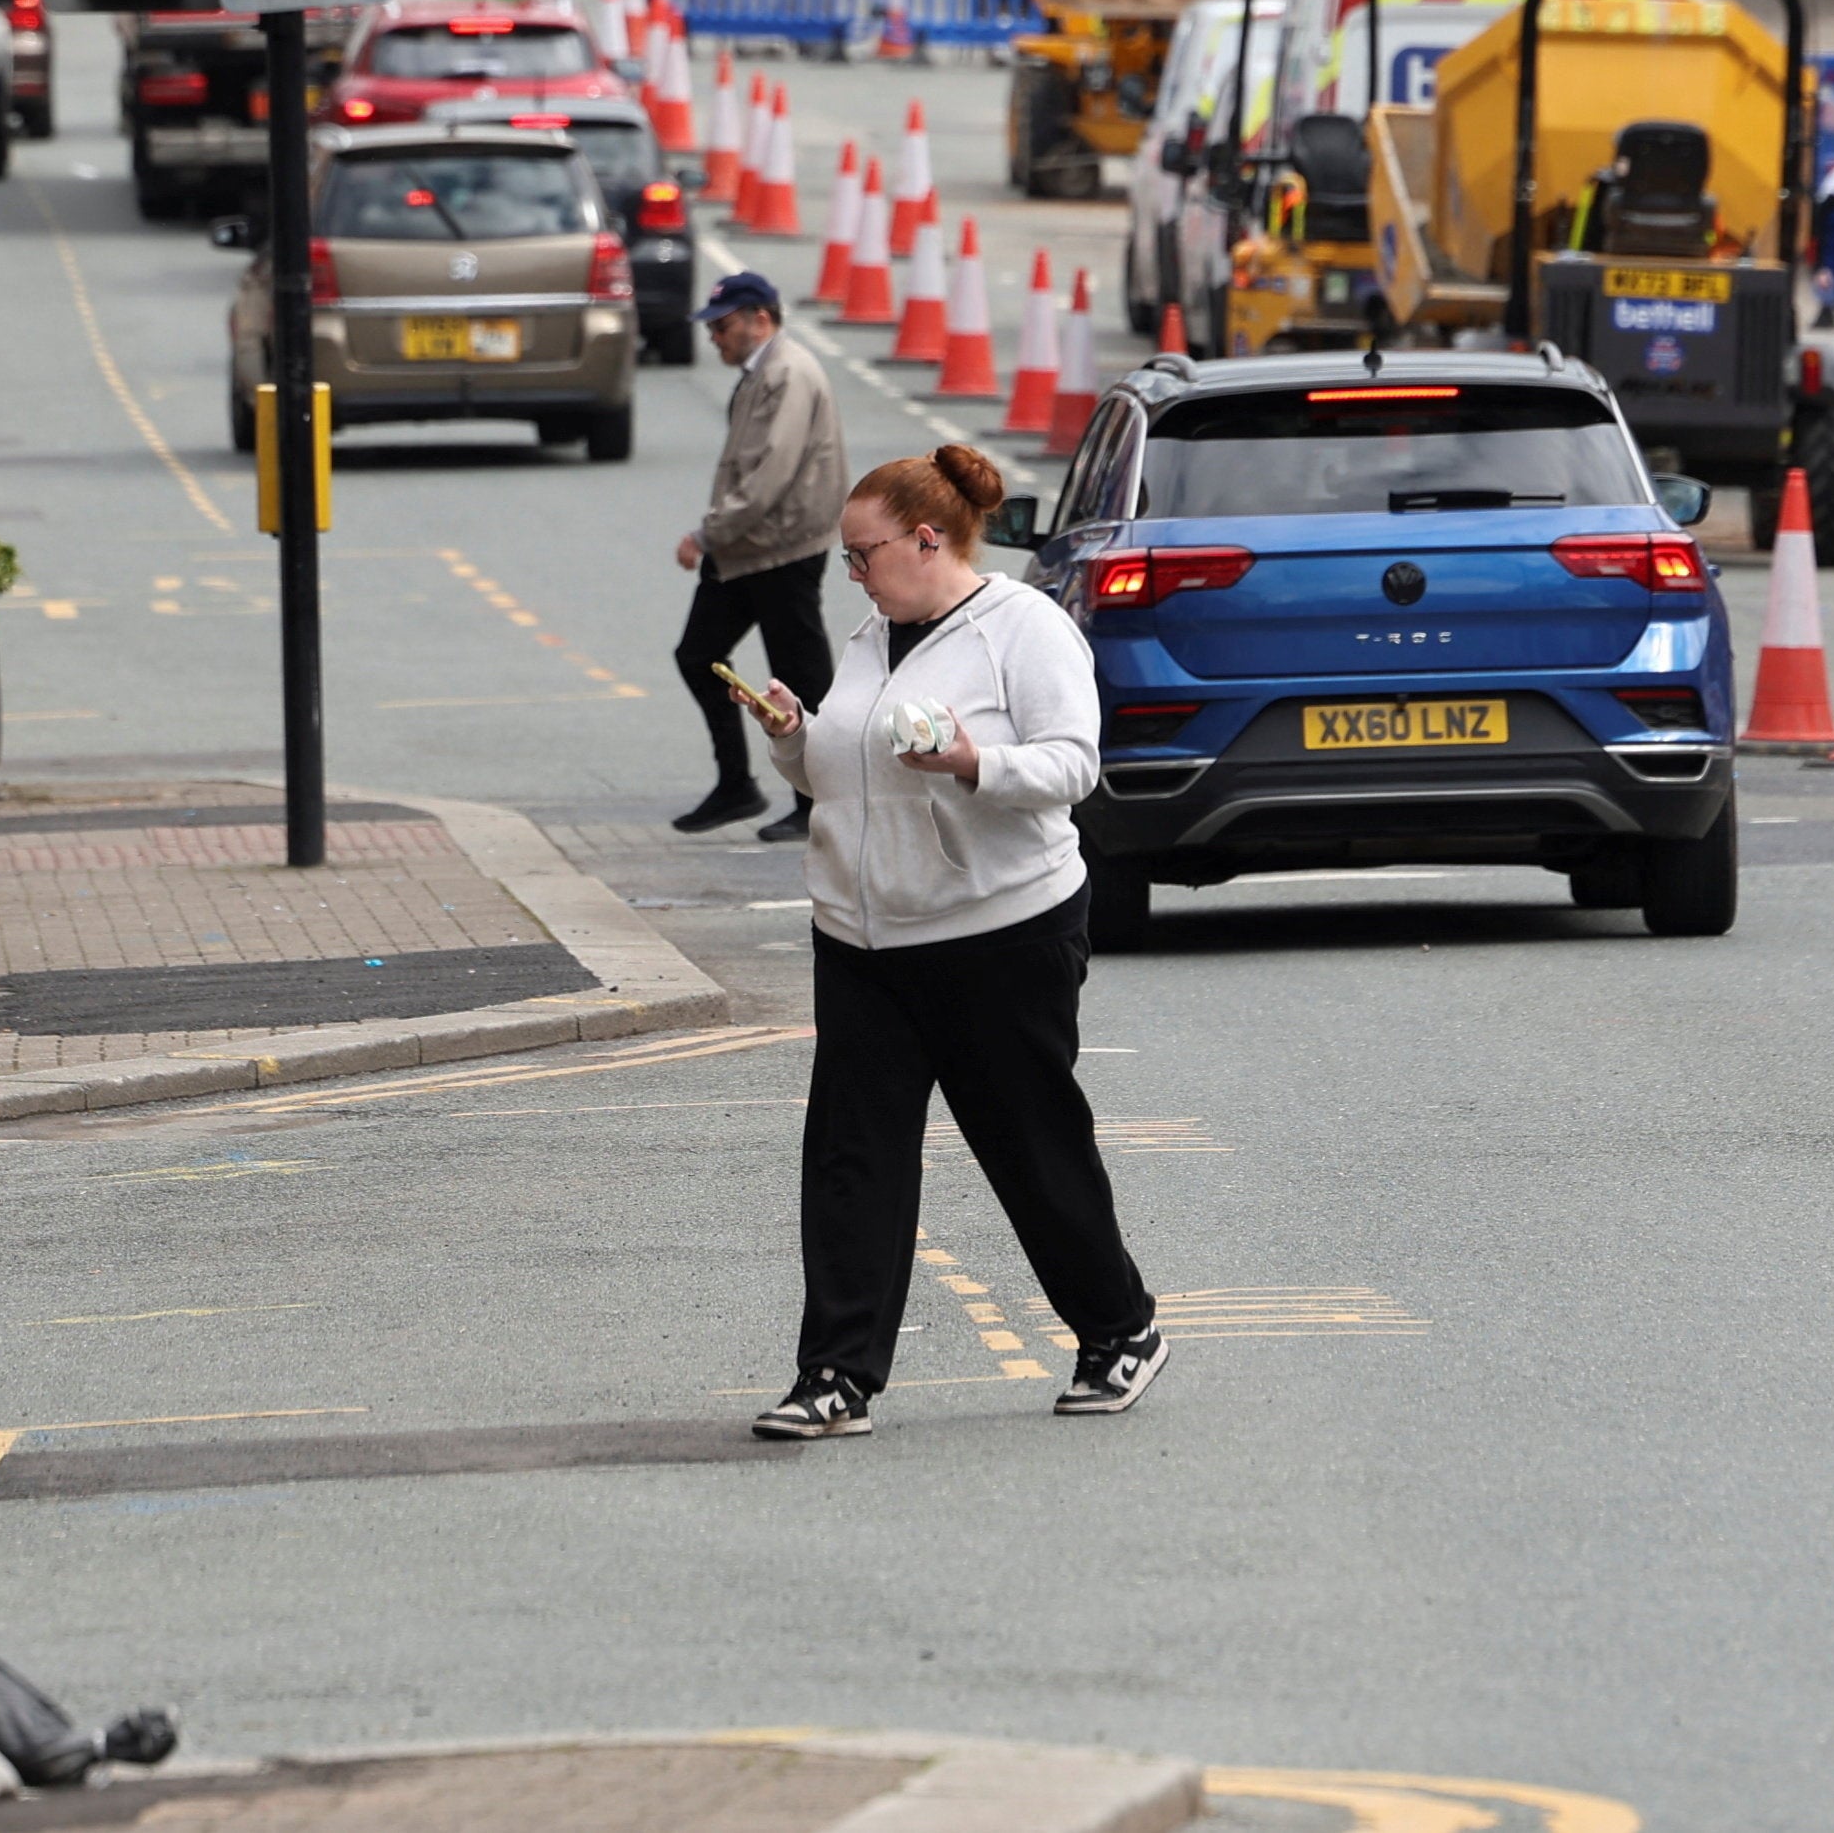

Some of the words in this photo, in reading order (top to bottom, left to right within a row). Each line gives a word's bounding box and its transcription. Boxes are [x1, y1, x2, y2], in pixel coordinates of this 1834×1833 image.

[1614, 298, 1716, 333] bethell
[1355, 631, 1453, 644] T-ROC
[1319, 709, 1412, 744] XX60
[1419, 707, 1491, 741] LNZ
